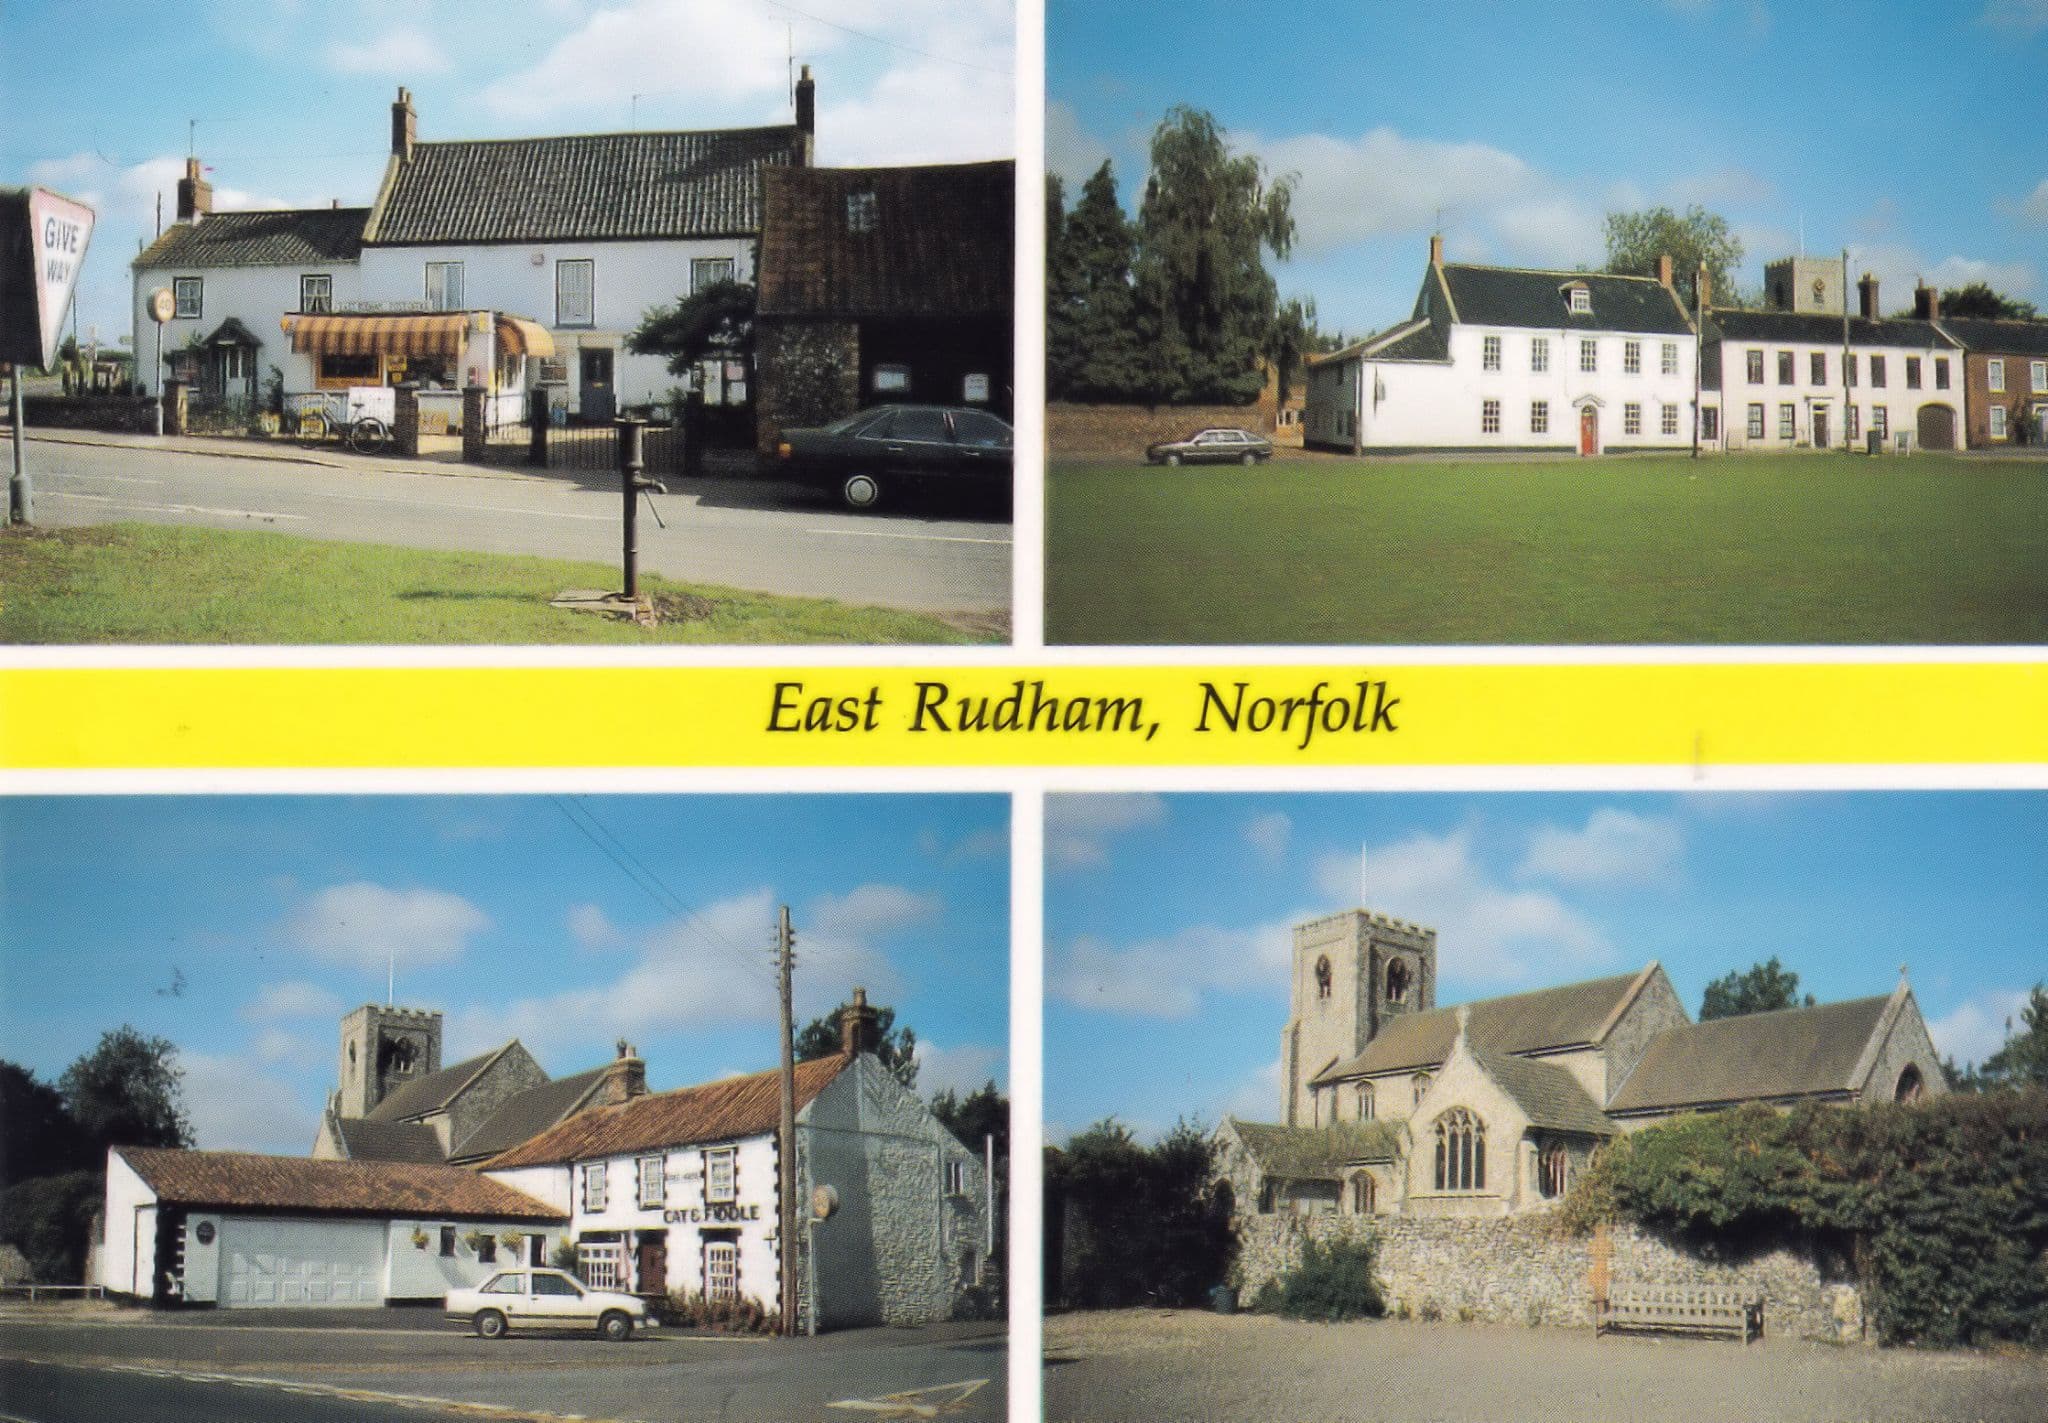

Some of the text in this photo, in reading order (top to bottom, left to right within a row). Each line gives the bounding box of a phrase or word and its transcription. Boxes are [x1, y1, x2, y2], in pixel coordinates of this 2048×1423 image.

[45, 216, 79, 254] GIVE
[47, 260, 71, 283] WAY
[663, 1209, 688, 1224] CAT
